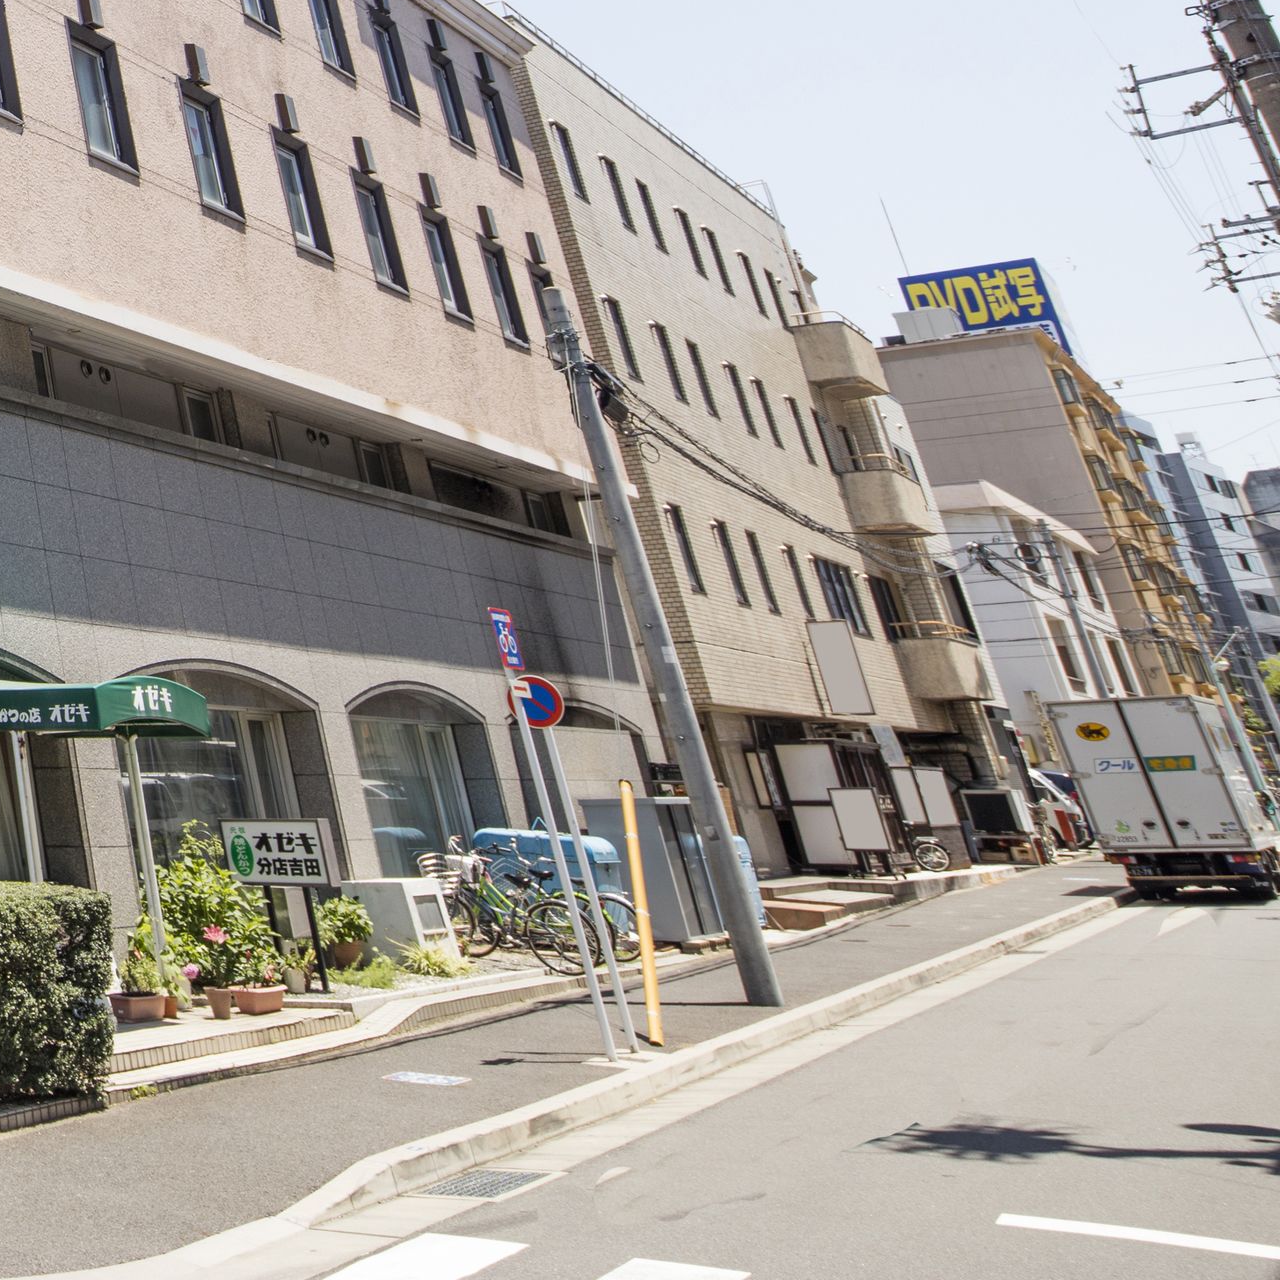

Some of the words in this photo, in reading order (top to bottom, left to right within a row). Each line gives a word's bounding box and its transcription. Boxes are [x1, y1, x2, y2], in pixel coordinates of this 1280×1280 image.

[131, 685, 173, 712] オゼキ
[48, 703, 90, 723] オゼキ
[1098, 759, 1134, 771] クール
[252, 832, 318, 855] オゼキ
[256, 857, 322, 877] 分店吉田
